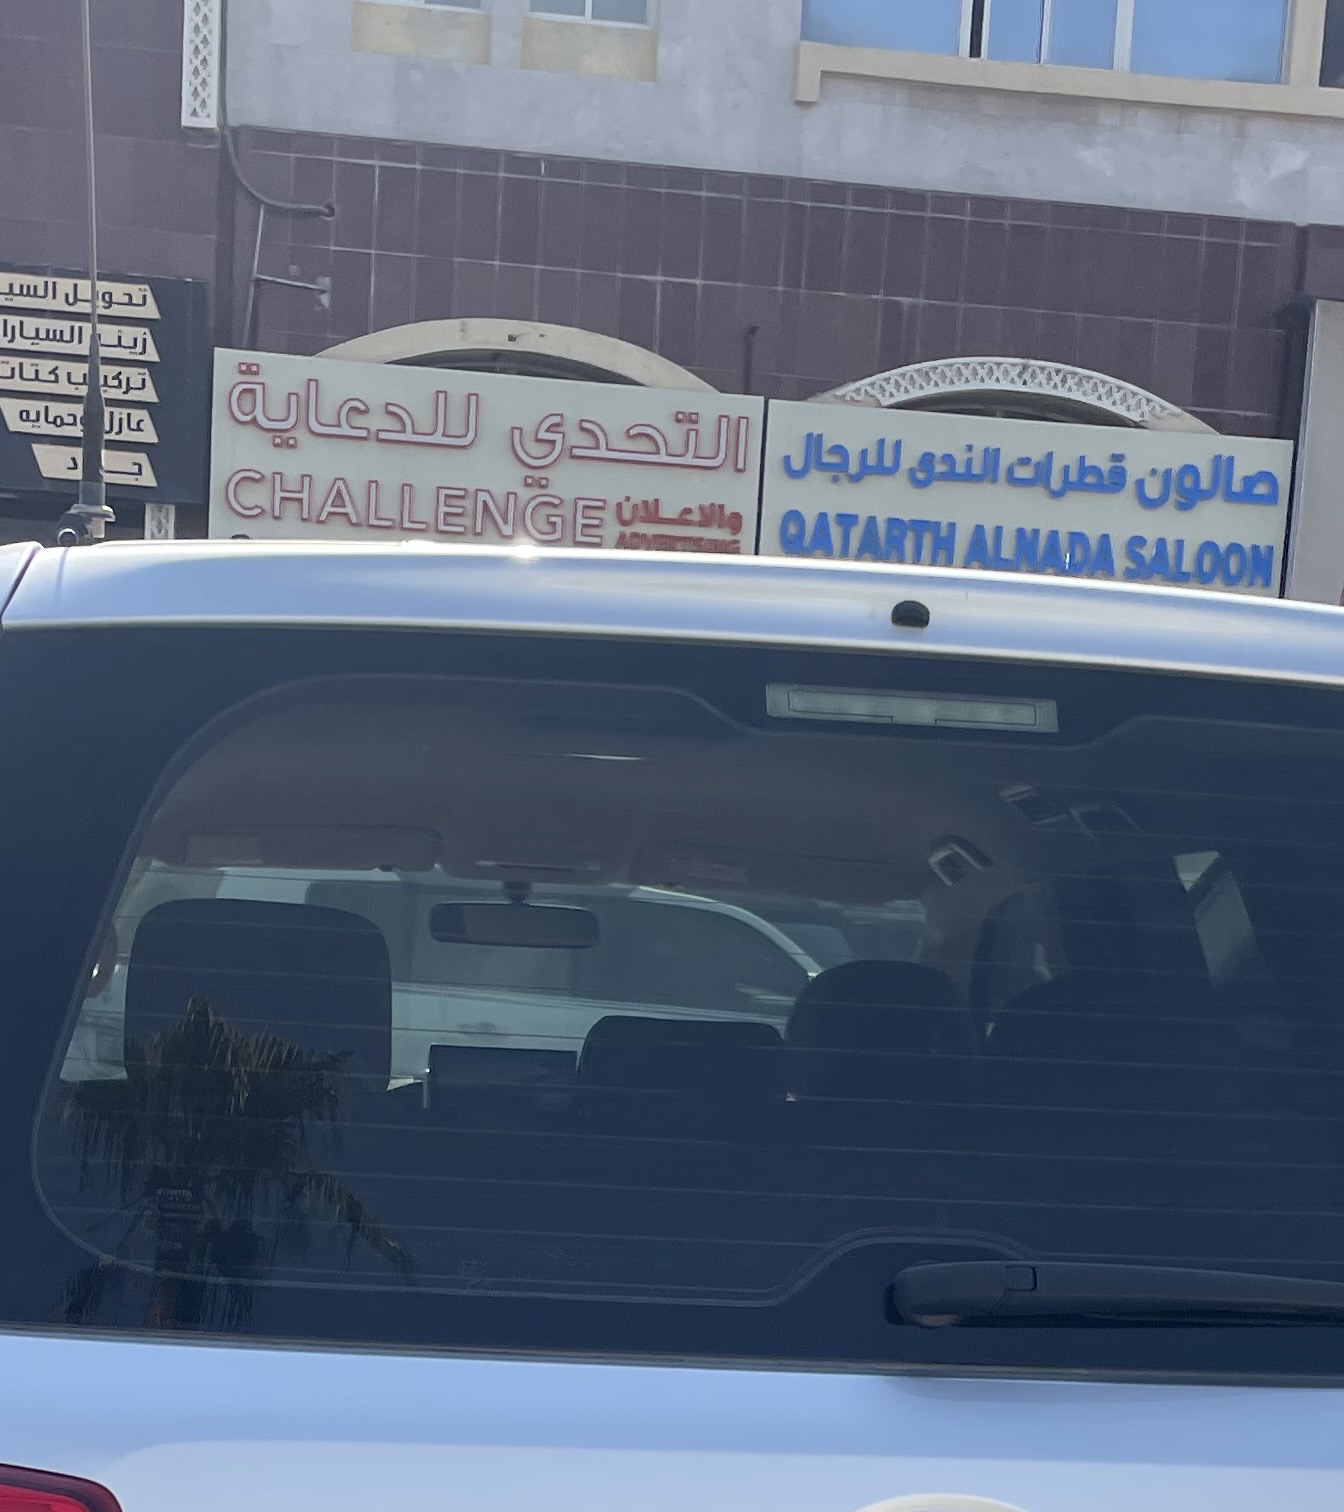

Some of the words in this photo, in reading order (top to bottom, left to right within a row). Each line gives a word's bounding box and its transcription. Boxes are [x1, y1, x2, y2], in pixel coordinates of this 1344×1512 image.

[228, 361, 481, 449] للدعاية
[510, 409, 750, 488] التحدي
[782, 432, 902, 484] للرجال
[1006, 450, 1128, 499] قطرات
[1135, 454, 1280, 511] صالون
[225, 468, 607, 546] CHALLENGE
[779, 508, 956, 566] QATARTH
[963, 522, 1115, 577] ALNADA
[1123, 534, 1276, 588] SALOON
